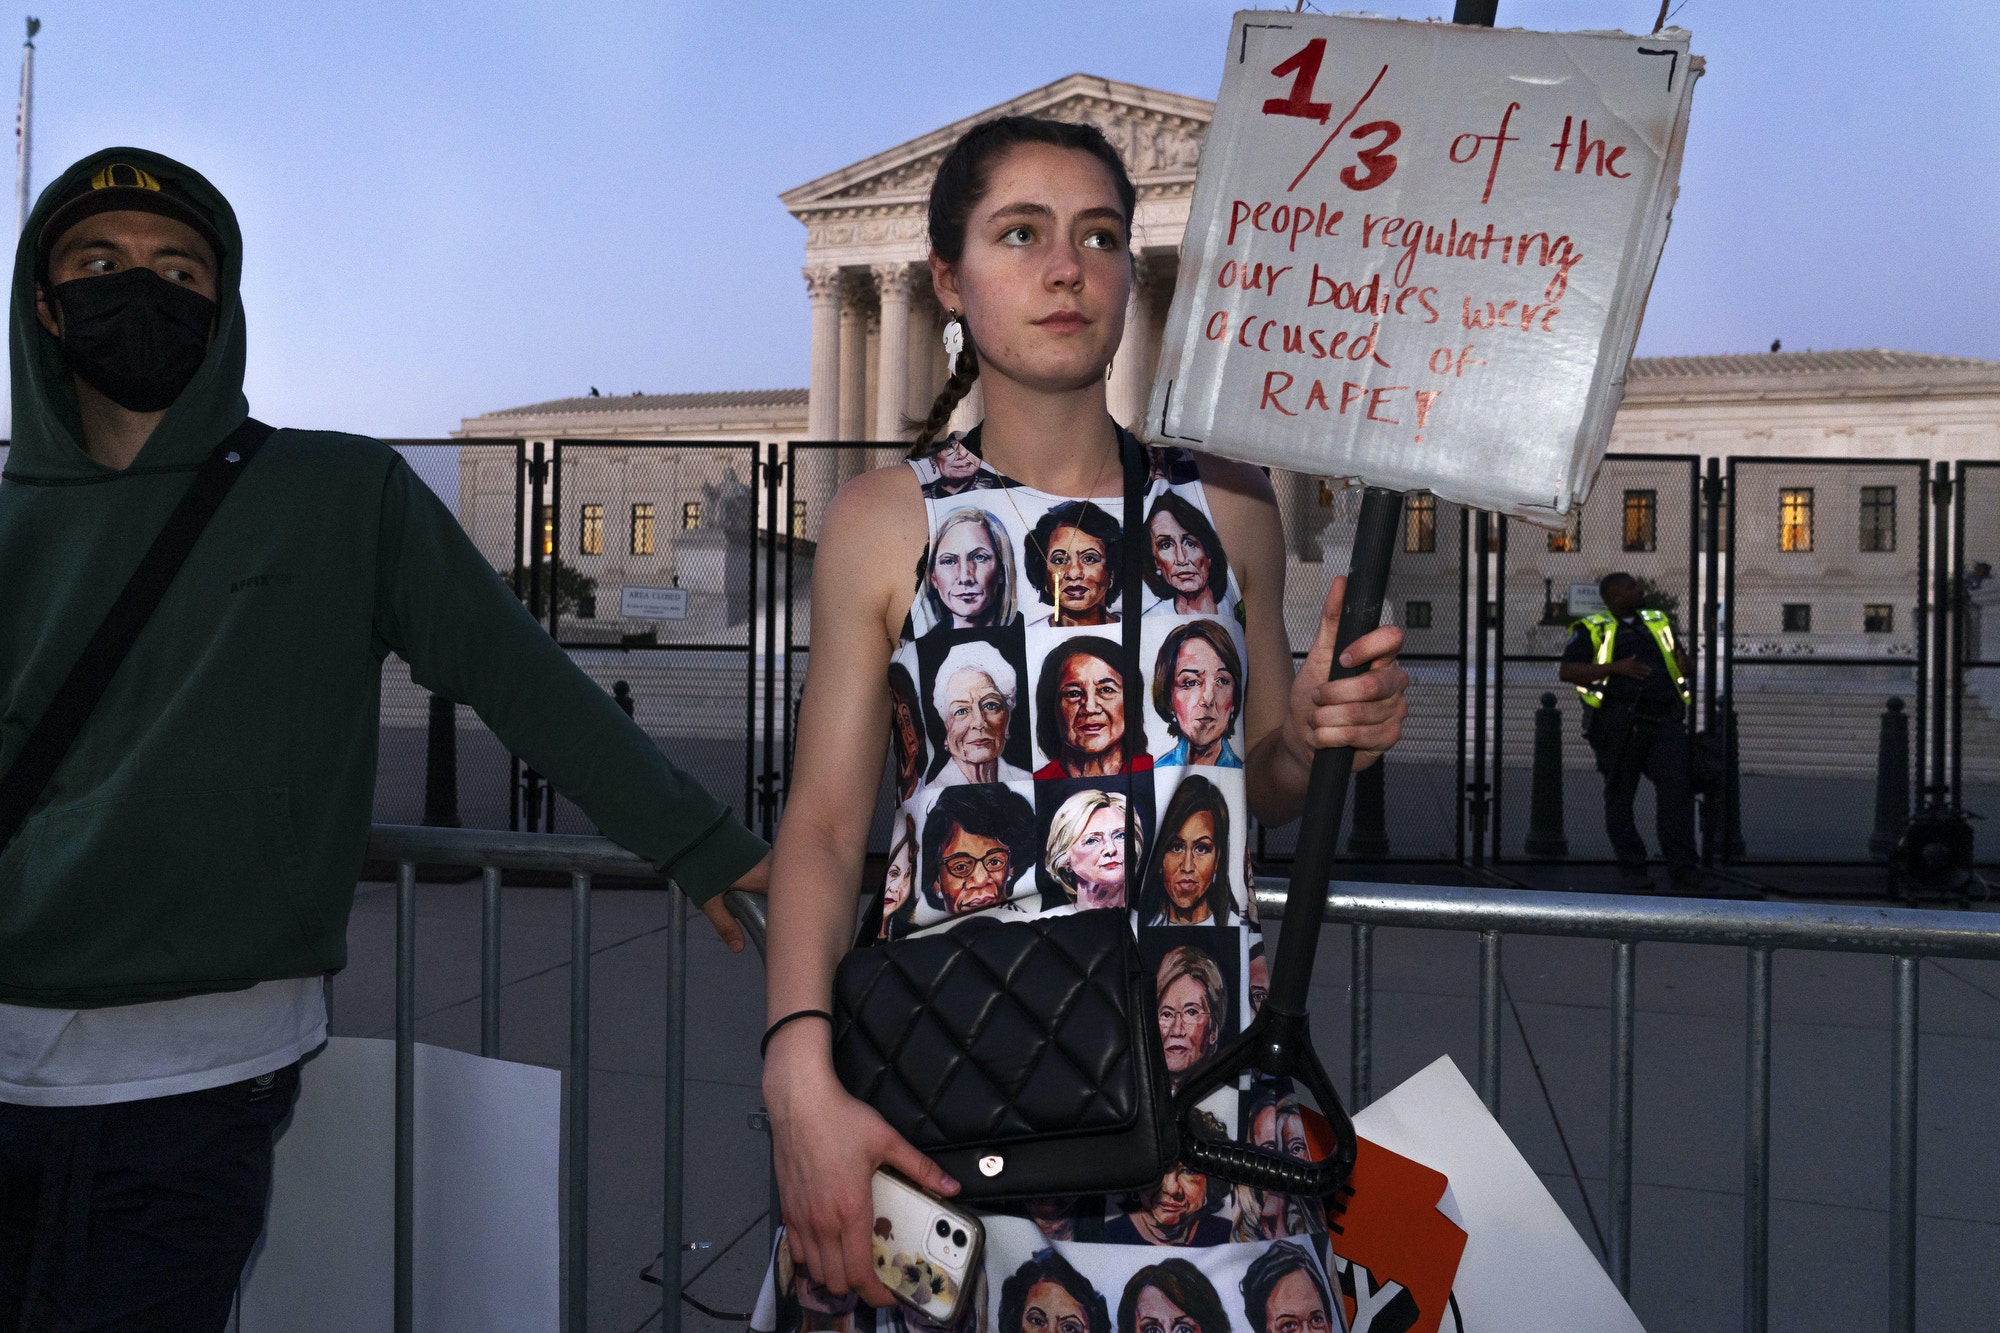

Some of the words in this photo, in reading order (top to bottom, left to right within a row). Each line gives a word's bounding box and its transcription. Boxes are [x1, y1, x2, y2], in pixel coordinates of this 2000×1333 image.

[1449, 101, 1520, 204] of
[1550, 114, 1632, 179] the
[1227, 200, 1342, 251] people
[1362, 212, 1584, 302] regulating
[1217, 259, 1293, 294] our
[1306, 263, 1439, 324] bodies
[1461, 295, 1561, 333] were
[1206, 309, 1391, 369] accused
[1428, 344, 1489, 378] of
[1259, 371, 1442, 443] RAPE!
